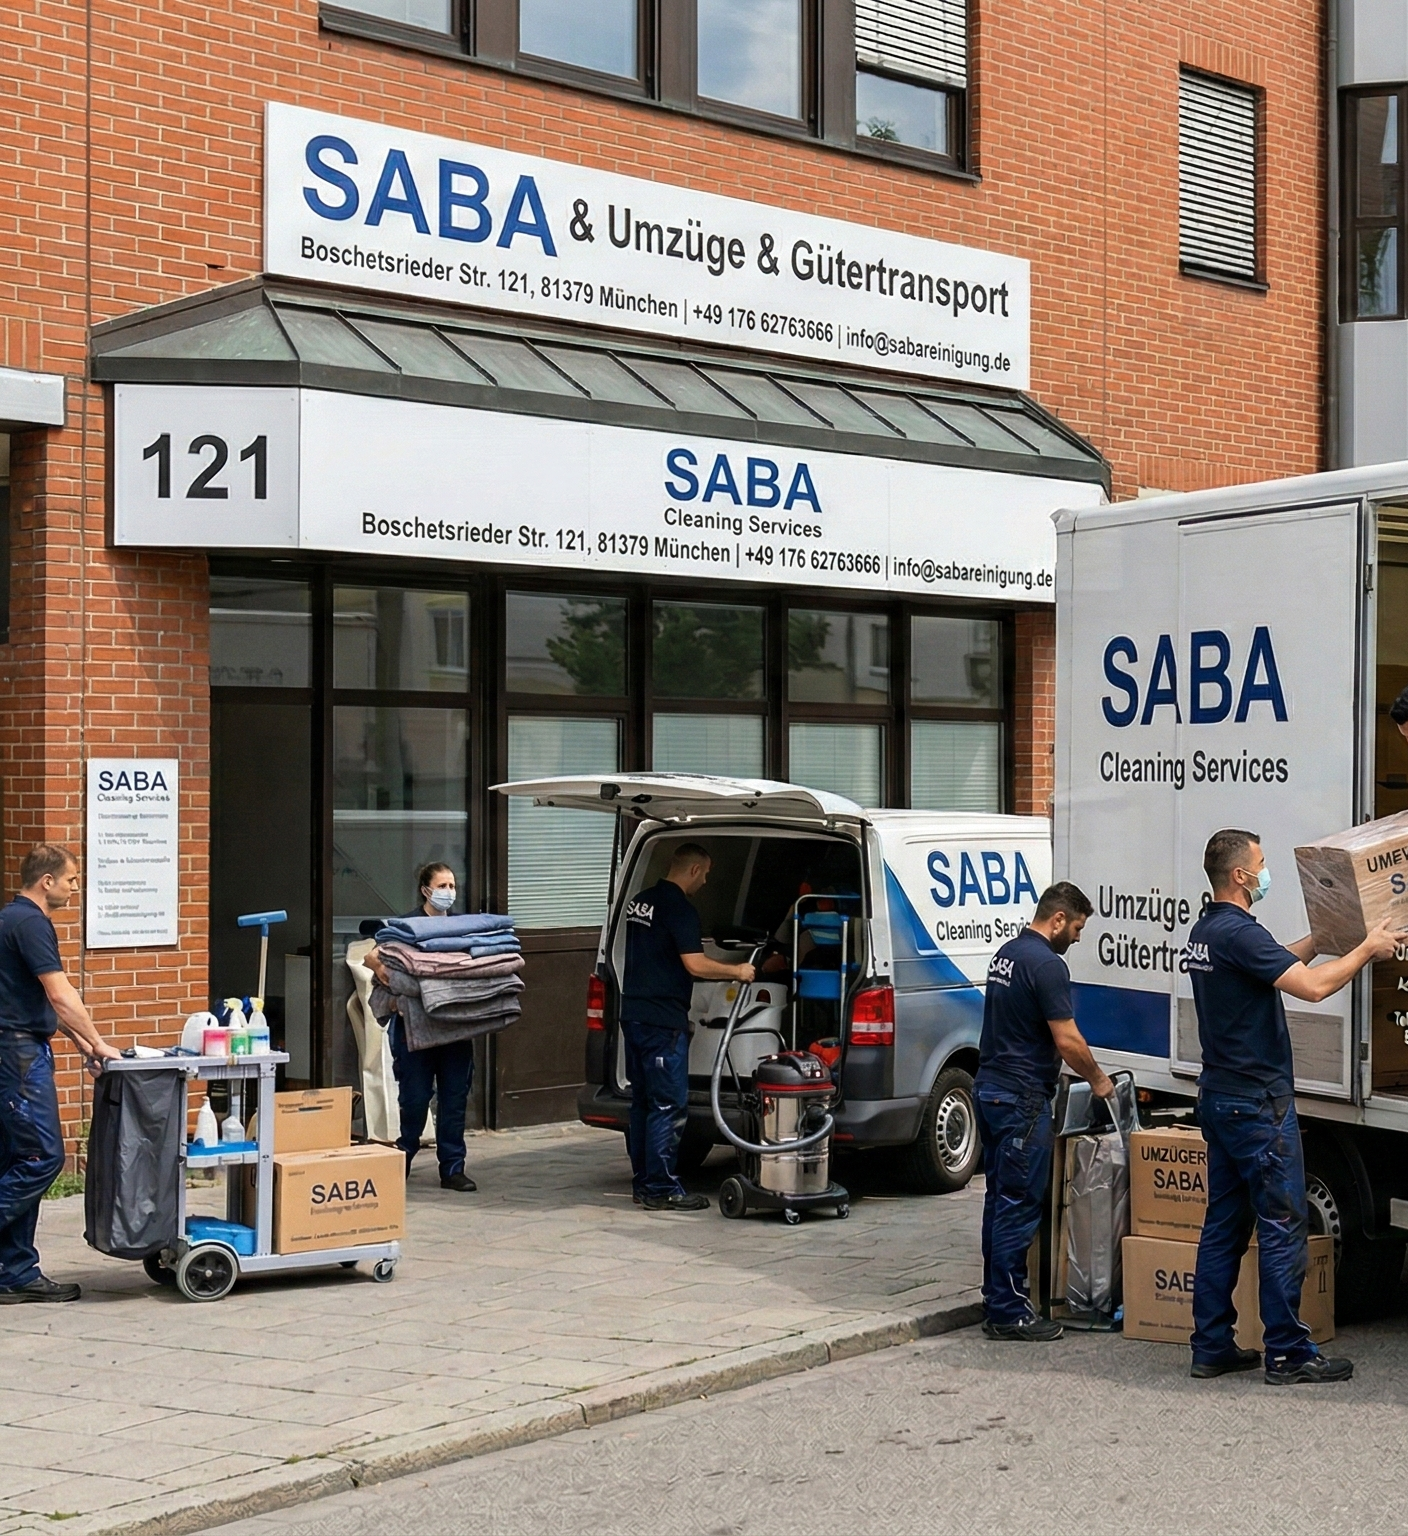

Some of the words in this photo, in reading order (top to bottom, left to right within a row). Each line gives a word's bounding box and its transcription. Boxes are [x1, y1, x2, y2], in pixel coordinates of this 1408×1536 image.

[302, 134, 558, 259] SABA
[569, 198, 595, 243] &
[608, 204, 746, 277] Umzüge
[757, 233, 780, 278] &
[791, 240, 1009, 318] Gütertransport
[301, 236, 454, 282] Boschetsrieder
[459, 263, 491, 288] Str.
[498, 269, 535, 299] 121,
[542, 277, 594, 305] 81379
[600, 286, 678, 318] München
[693, 303, 723, 325] +49
[729, 307, 756, 331] 176
[761, 312, 834, 343] 62763666
[846, 328, 1011, 373] info@sabareinigung.de
[143, 433, 268, 500] 121
[664, 449, 823, 514] SABA
[664, 507, 743, 536] Cleaning
[749, 515, 823, 538] Services
[362, 513, 514, 546] Boschetsrieder
[519, 526, 551, 549] Str.
[556, 529, 592, 556] 121,
[598, 532, 649, 557] 81379
[655, 537, 730, 563] München
[746, 545, 774, 567] +49
[780, 547, 806, 569] 176
[811, 550, 881, 575] 62763666
[893, 557, 1053, 591] info@sabareinigung.de
[1101, 625, 1289, 728] SABA
[98, 770, 168, 792] SABA
[1100, 750, 1185, 791] Cleaning
[1192, 749, 1289, 783] Services
[927, 850, 1039, 908] SABA
[936, 920, 993, 944] Cleaning
[1099, 885, 1190, 933] Umzüge
[1141, 1145, 1208, 1166] UMZÜGER
[311, 1178, 378, 1205] SABA
[1153, 1168, 1206, 1193] SABA
